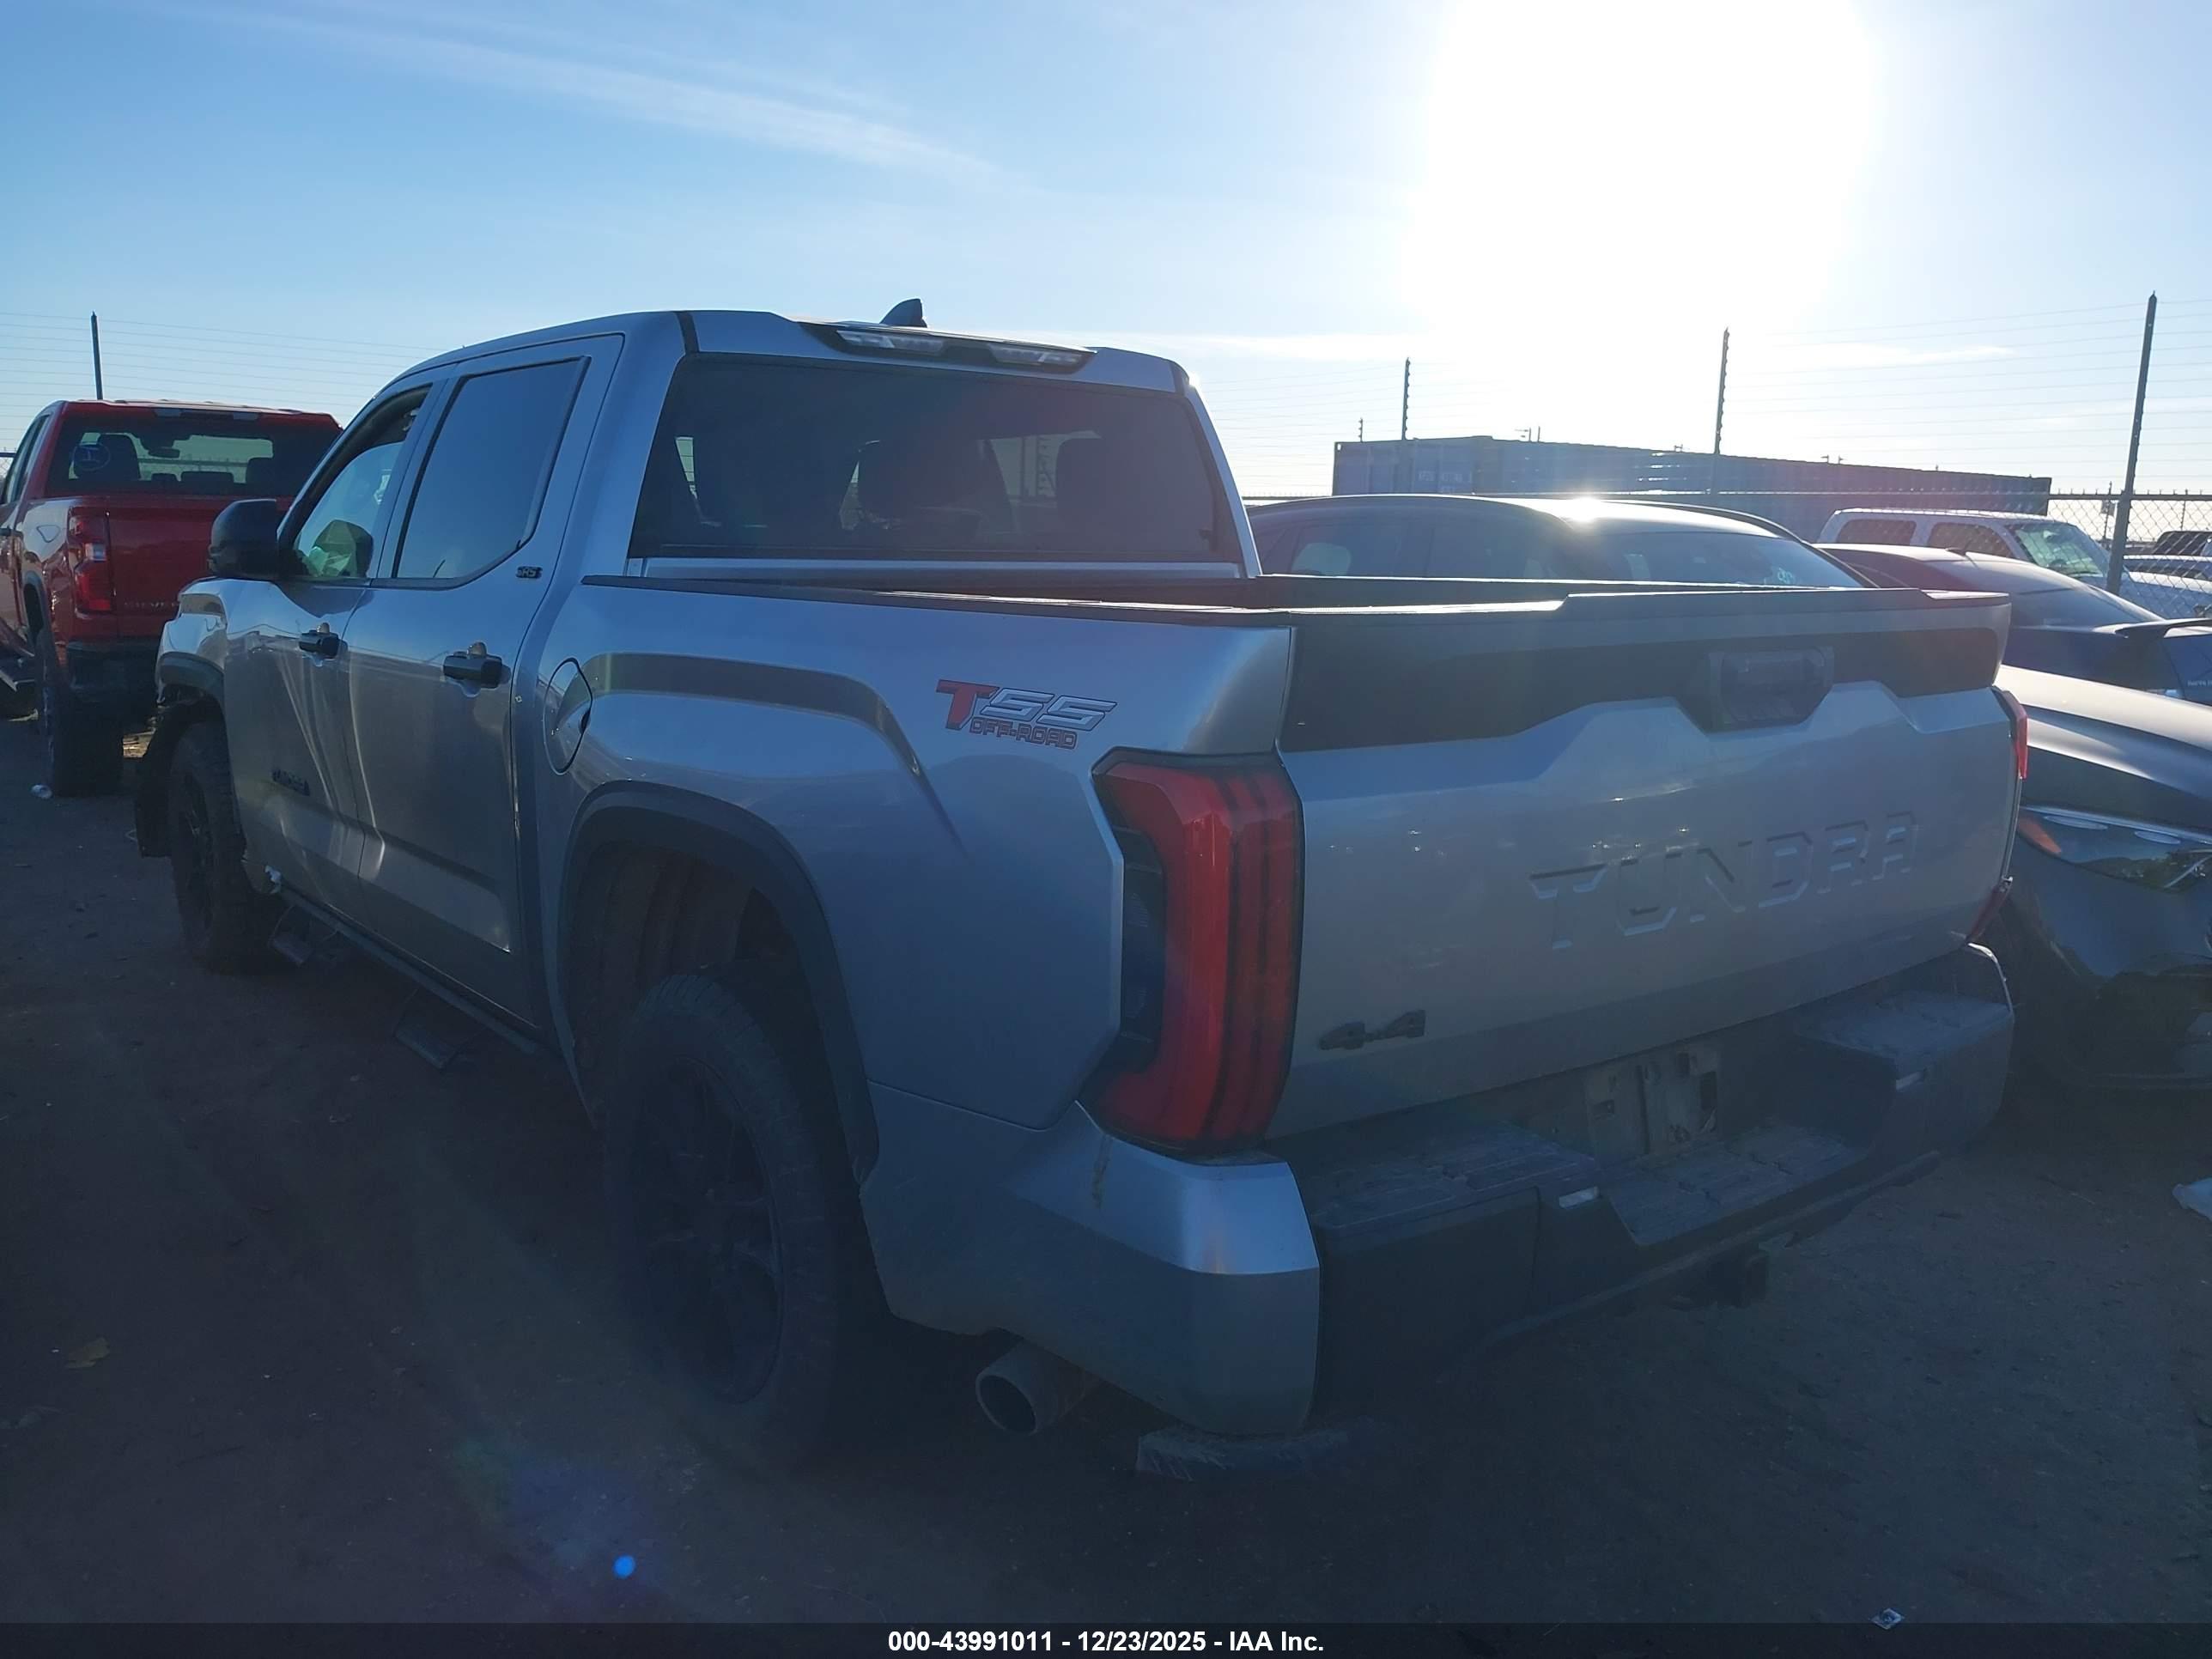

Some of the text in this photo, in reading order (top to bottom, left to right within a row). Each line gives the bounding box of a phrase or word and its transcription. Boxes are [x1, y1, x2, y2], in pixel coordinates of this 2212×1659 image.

[935, 679, 1117, 731] TSS
[969, 716, 1078, 750] OFF-ROAD
[1529, 811, 1920, 949] TUNDRA
